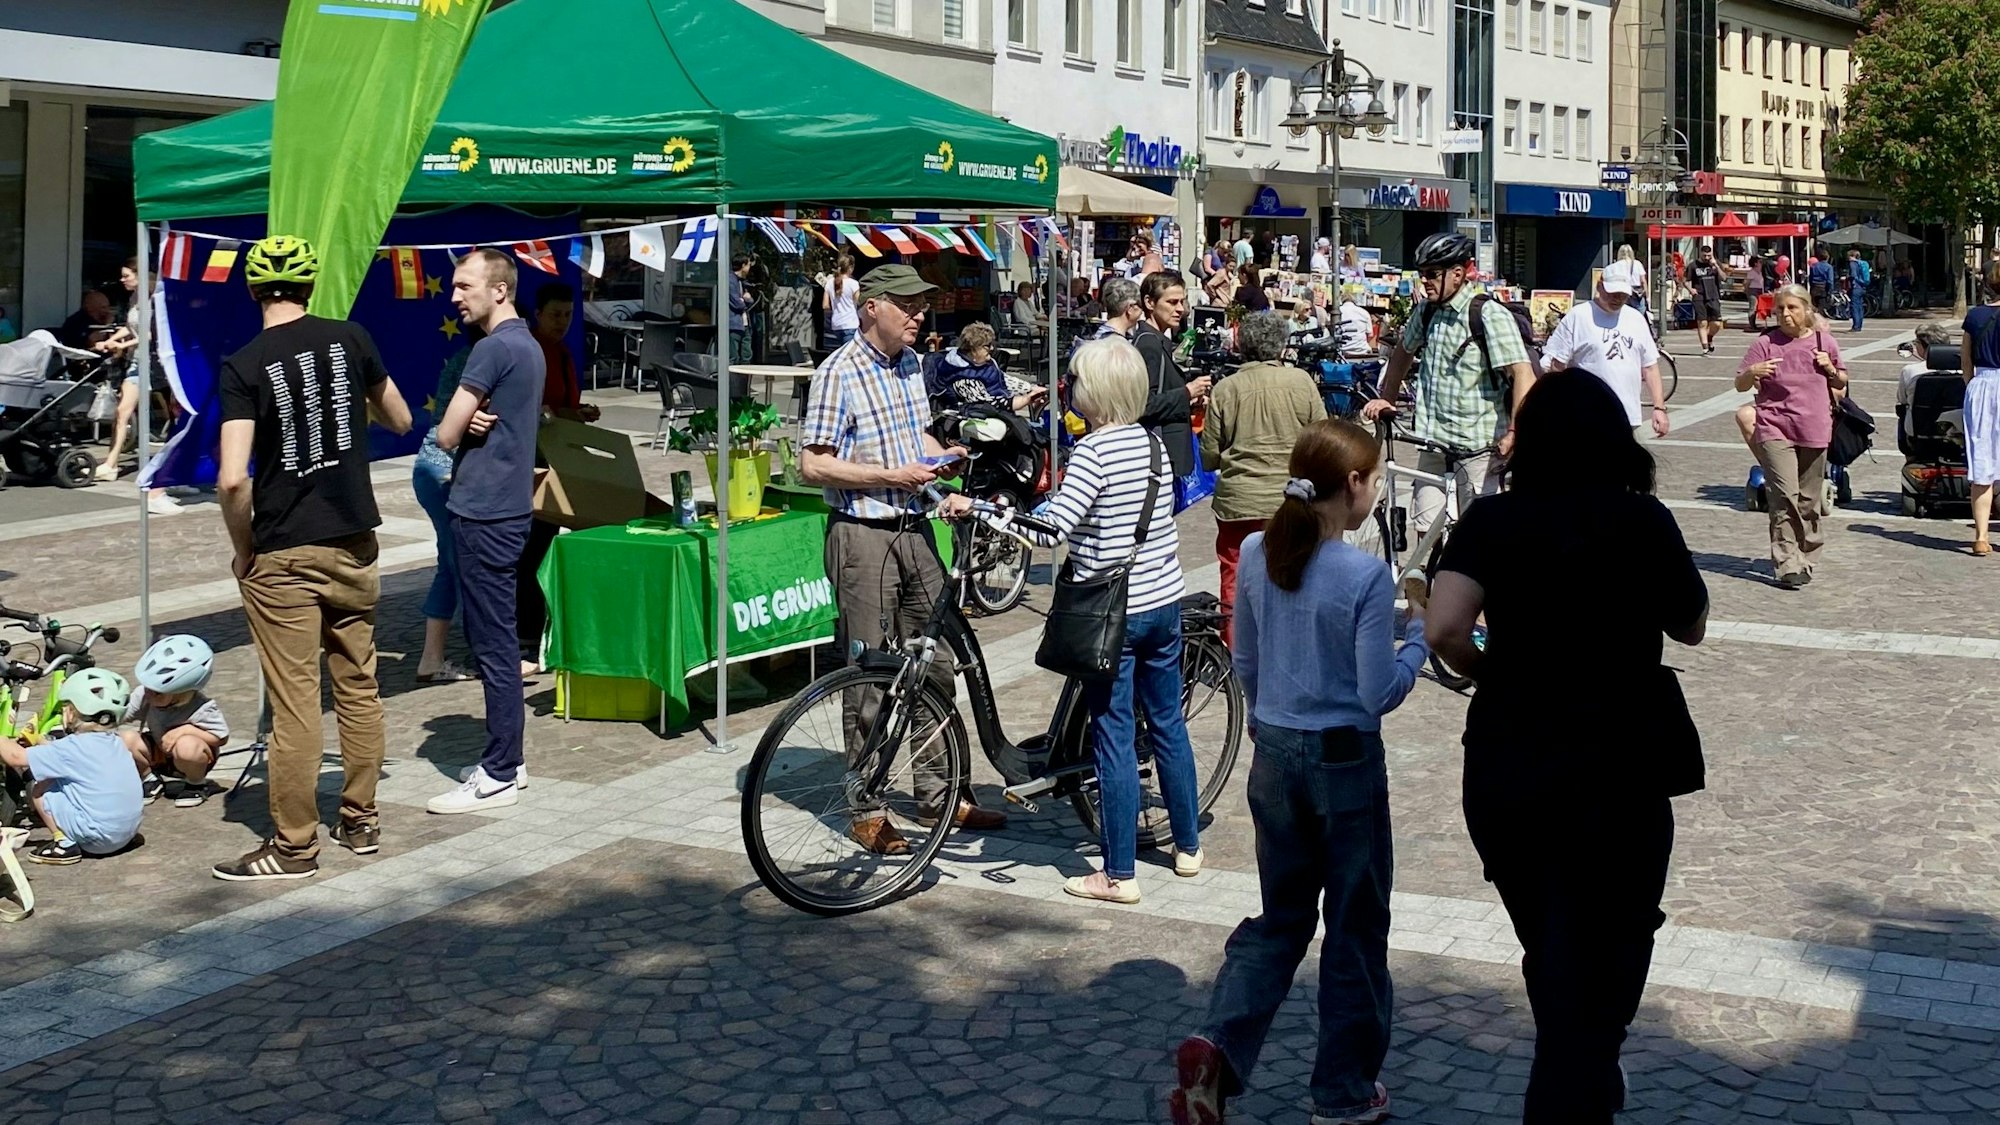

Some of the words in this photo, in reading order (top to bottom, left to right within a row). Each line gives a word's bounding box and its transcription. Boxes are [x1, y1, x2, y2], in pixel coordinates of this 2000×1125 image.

[489, 158, 617, 175] WWW.GRUENE.DE
[958, 161, 1017, 180] WWW.GRUENE.DE
[1602, 171, 1628, 180] KIND
[1420, 186, 1451, 212] BANK
[1558, 191, 1592, 213] KIND
[733, 595, 771, 633] DIE
